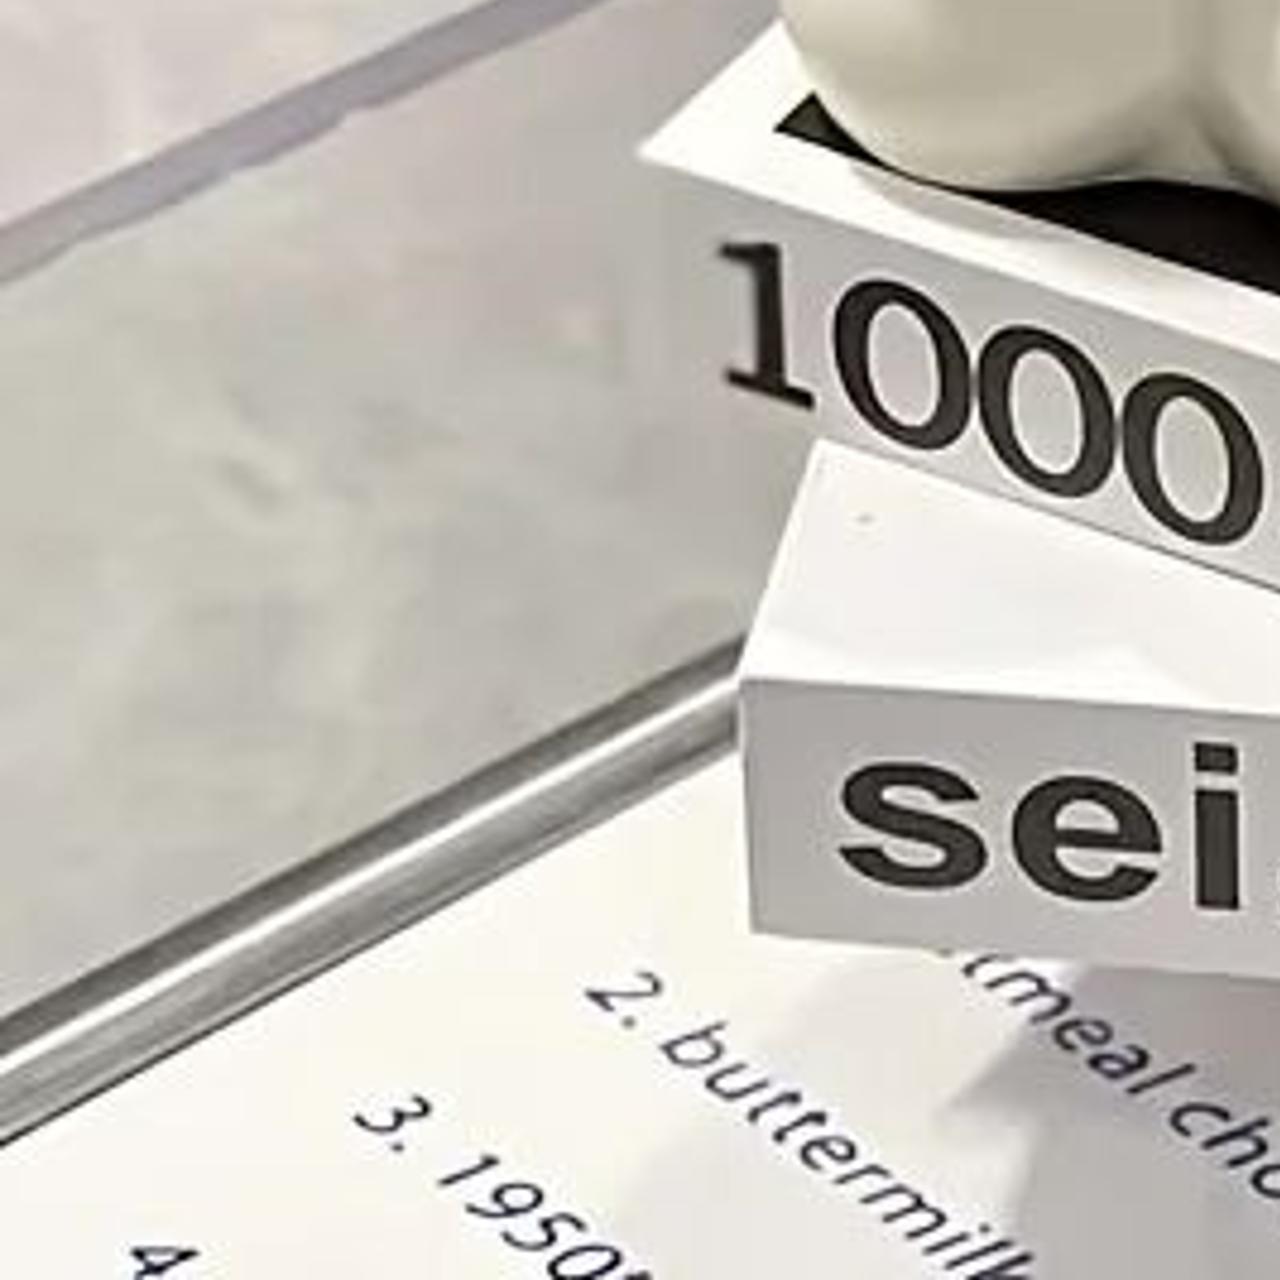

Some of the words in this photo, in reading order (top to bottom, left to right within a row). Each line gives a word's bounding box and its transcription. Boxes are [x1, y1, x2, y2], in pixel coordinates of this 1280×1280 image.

[719, 242, 1265, 546] 1000
[837, 740, 1242, 912] sei
[584, 970, 664, 1029] 2.
[352, 1094, 432, 1152] 3.
